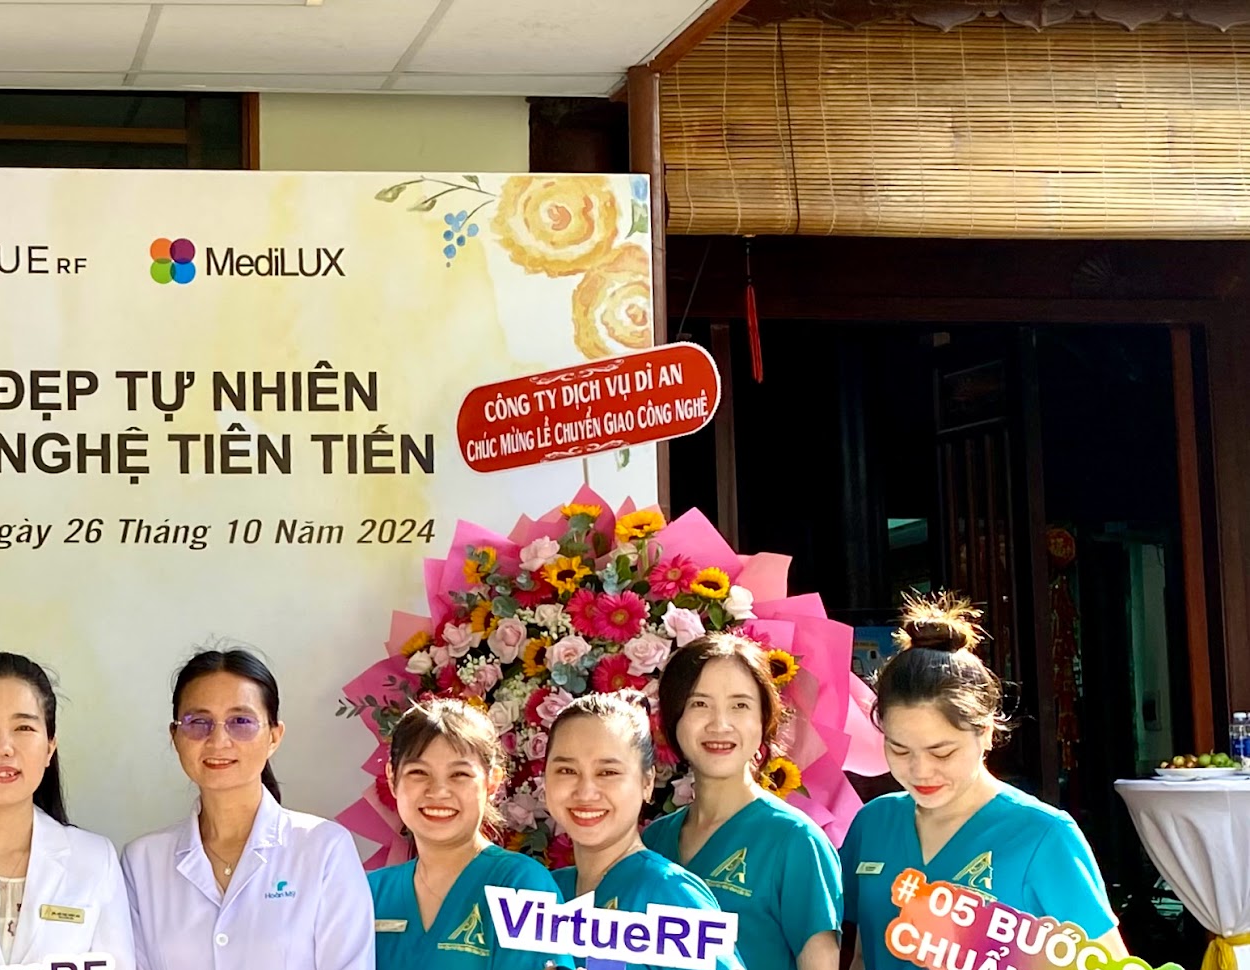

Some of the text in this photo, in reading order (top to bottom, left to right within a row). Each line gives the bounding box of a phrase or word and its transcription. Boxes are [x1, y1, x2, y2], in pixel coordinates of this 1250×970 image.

[56, 258, 88, 274] RF
[205, 247, 346, 277] MediLUX
[114, 370, 195, 423] TỰ
[212, 359, 379, 413] NHIÊN
[483, 392, 531, 422] CÔNG
[533, 388, 558, 412] TY
[562, 379, 601, 410] DỊCH
[604, 372, 632, 402] VỤ
[658, 362, 683, 388] AN
[167, 422, 292, 475] TIÊN
[310, 423, 435, 475] TIẾN
[466, 431, 498, 462] CHÚC
[603, 409, 635, 436] GIAO
[636, 398, 673, 429] CÔNG
[674, 388, 709, 423] NGHỆ
[63, 518, 105, 543] 26
[118, 518, 212, 551] Tháng
[227, 518, 263, 544] 10
[274, 519, 345, 544] Năm
[356, 518, 436, 544] 2024
[896, 873, 921, 904] #
[928, 886, 977, 927] 05
[498, 897, 728, 960] VirtueRF
